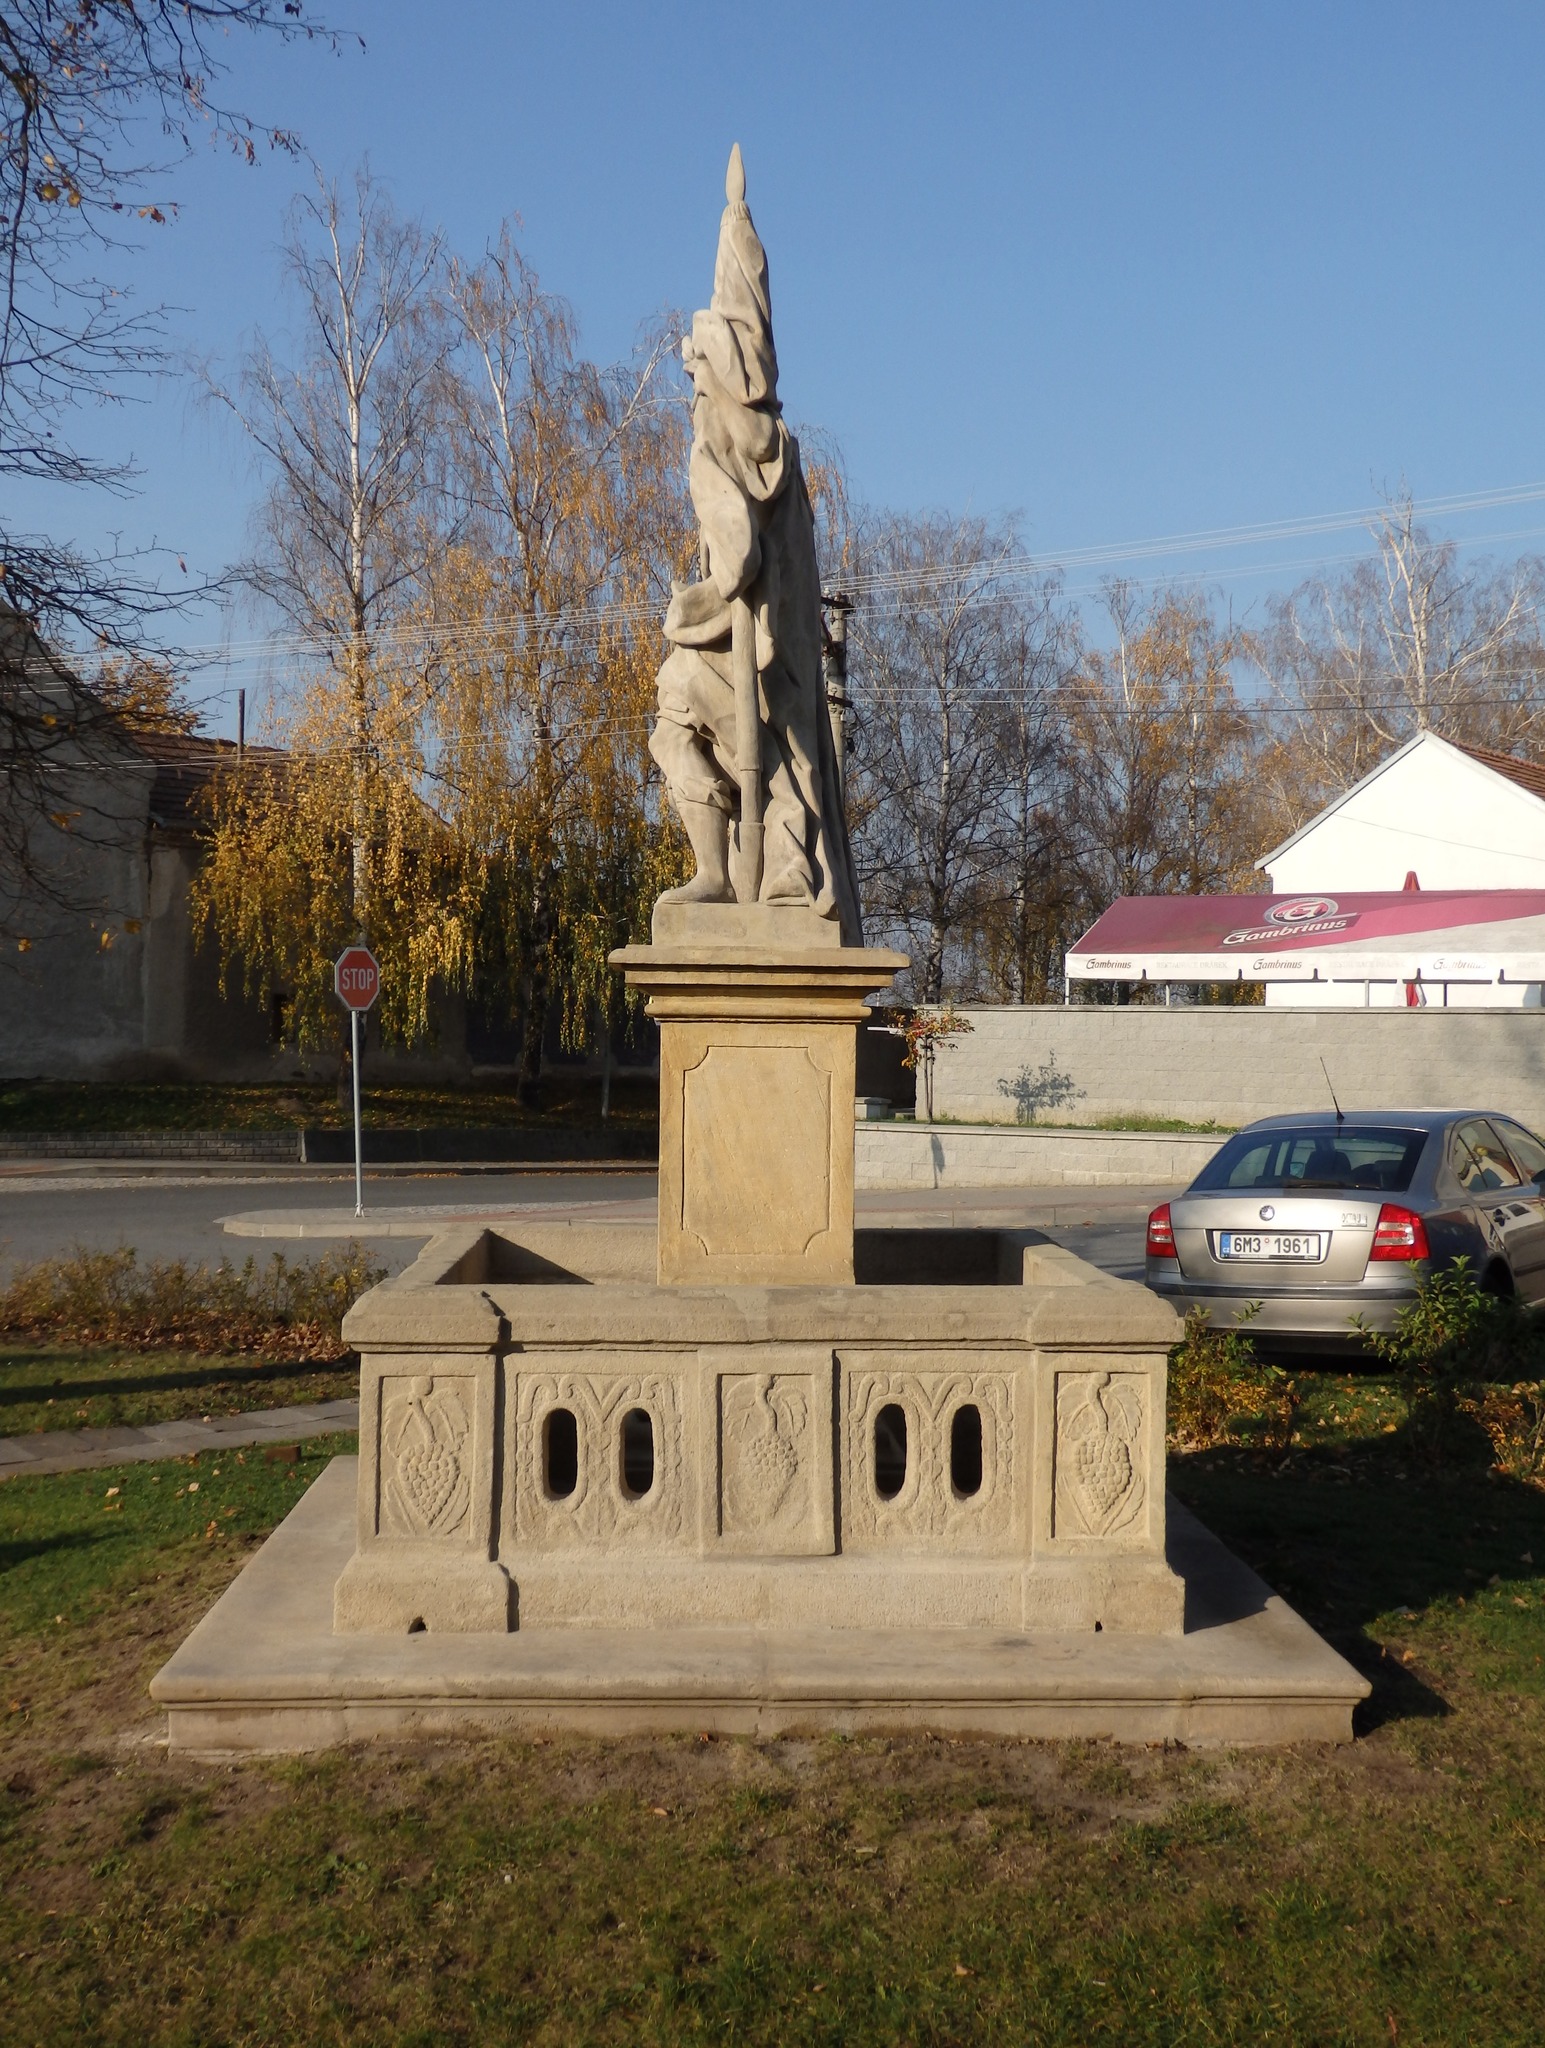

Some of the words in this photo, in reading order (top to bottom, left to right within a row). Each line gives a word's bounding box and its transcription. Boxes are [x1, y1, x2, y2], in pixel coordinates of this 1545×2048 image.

[1223, 920, 1347, 945] Gambrinus
[1086, 958, 1132, 970] Gambrinus
[1253, 958, 1303, 970] Gambrinus
[342, 968, 374, 990] STOP
[1234, 1237, 1261, 1253] 6M3
[1274, 1238, 1310, 1254] 1961
